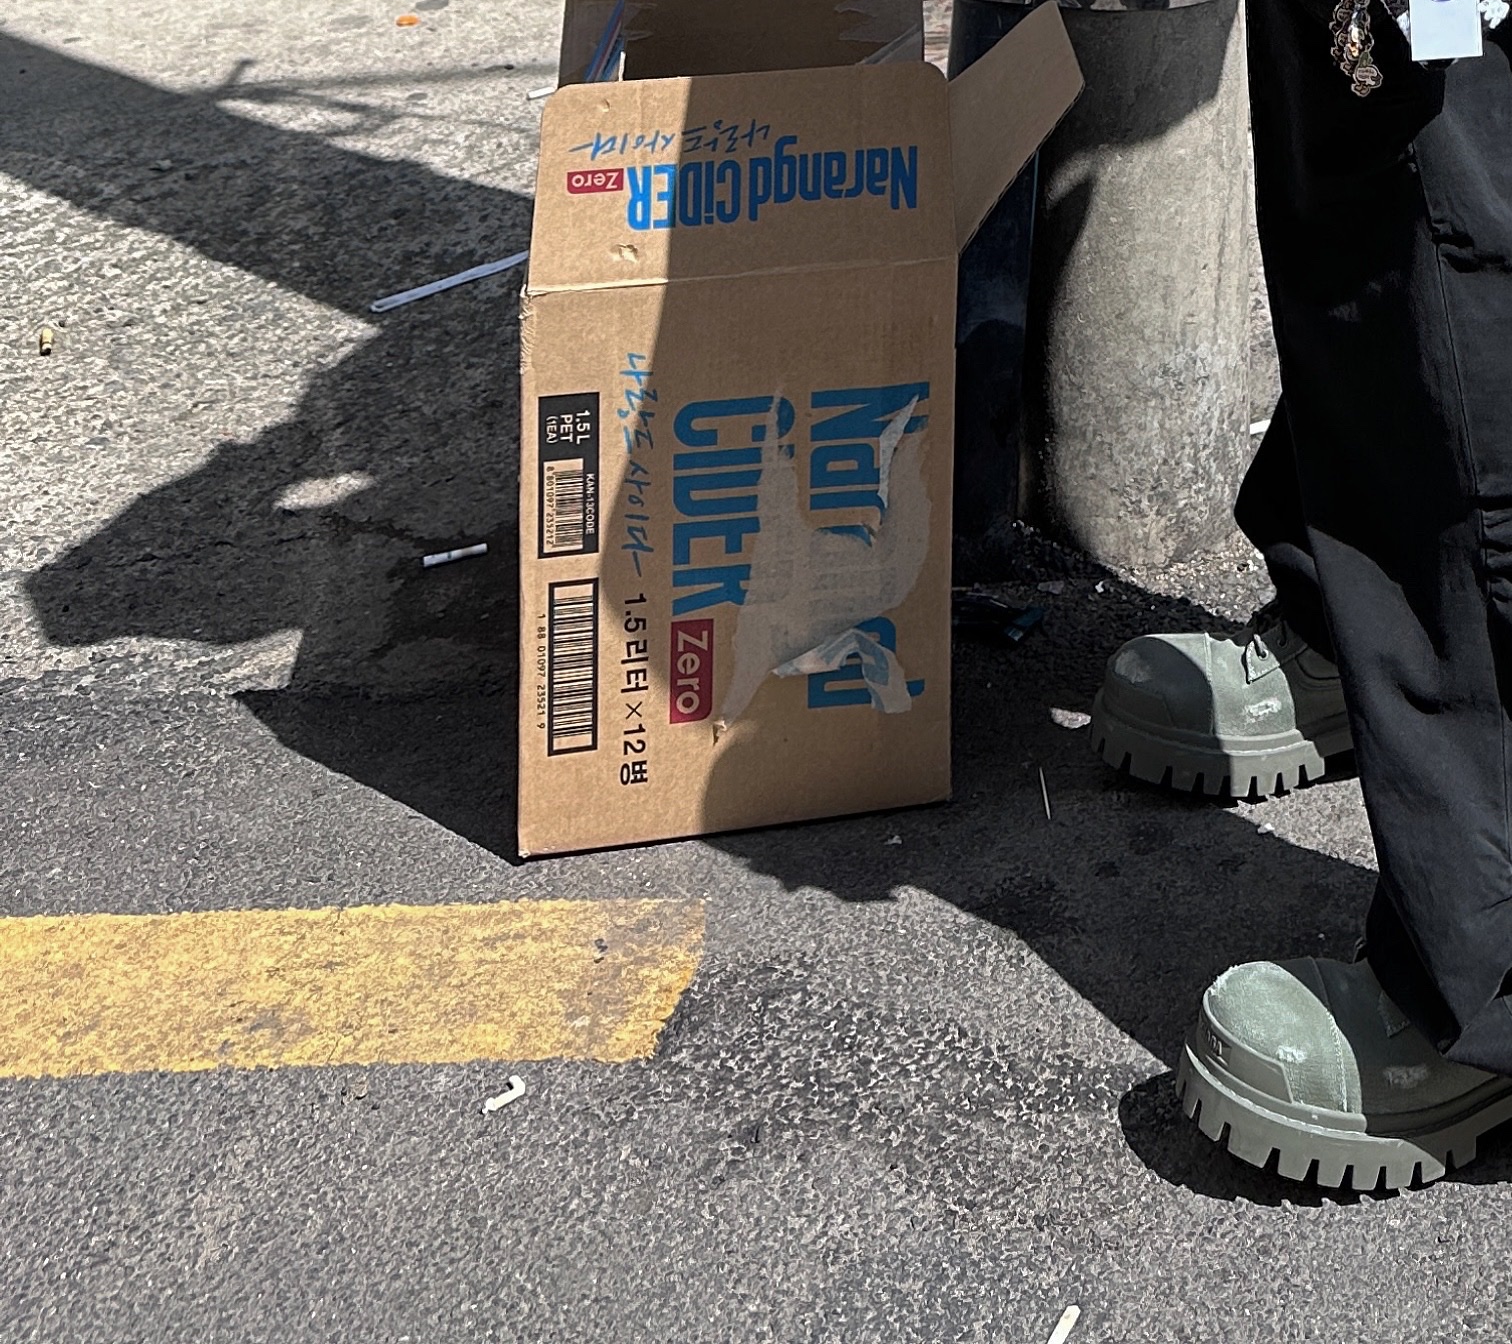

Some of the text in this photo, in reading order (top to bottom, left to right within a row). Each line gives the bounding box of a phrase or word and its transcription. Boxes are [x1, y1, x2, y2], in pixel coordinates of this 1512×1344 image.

[571, 169, 620, 190] Zero
[748, 135, 918, 221] Narangd
[545, 415, 558, 444] (1EA)
[560, 413, 573, 443] PET
[537, 626, 546, 640] 88
[537, 645, 546, 678] 01097
[675, 628, 708, 715] Zero
[537, 684, 546, 716] 23521
